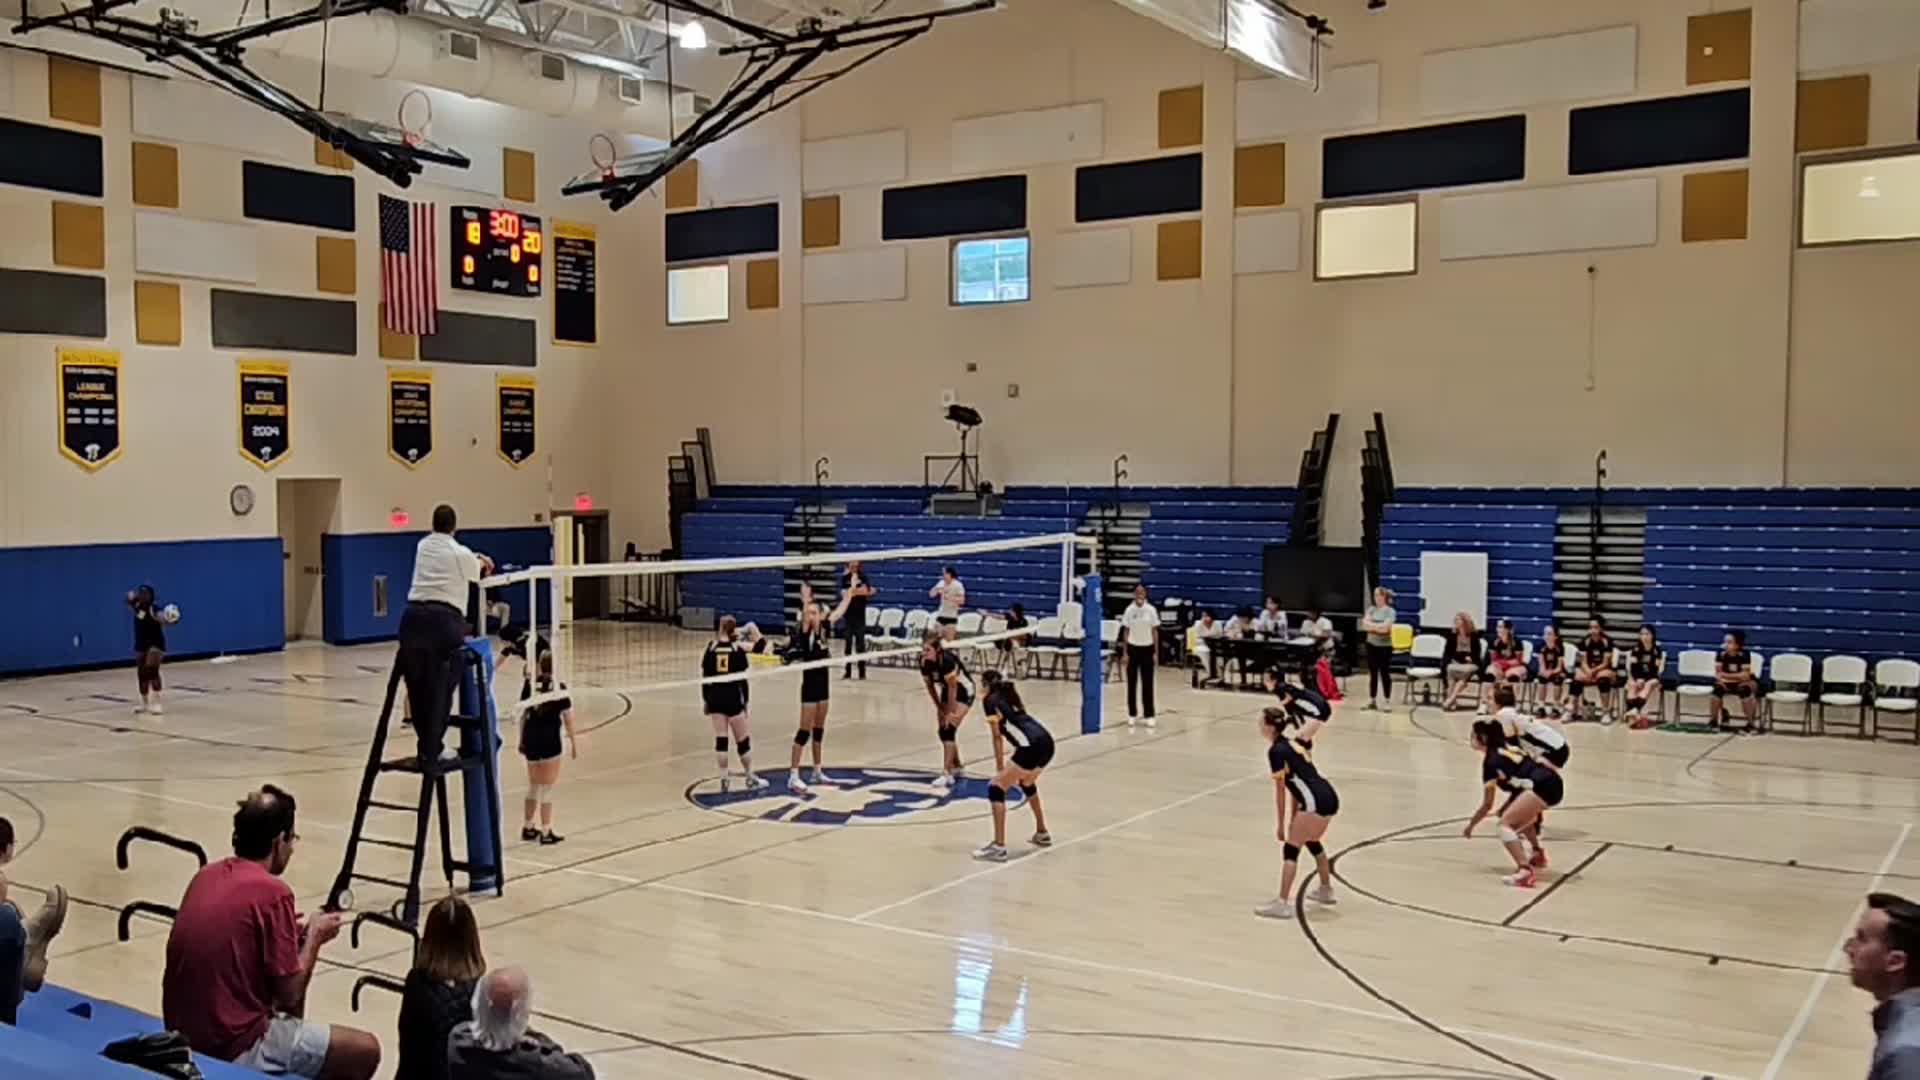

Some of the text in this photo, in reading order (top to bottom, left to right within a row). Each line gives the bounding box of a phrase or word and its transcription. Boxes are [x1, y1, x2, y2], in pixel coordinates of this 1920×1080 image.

[489, 210, 519, 239] 3:00
[522, 229, 541, 254] 20
[510, 243, 520, 263] 0
[463, 254, 474, 274] 0
[528, 264, 539, 282] 0
